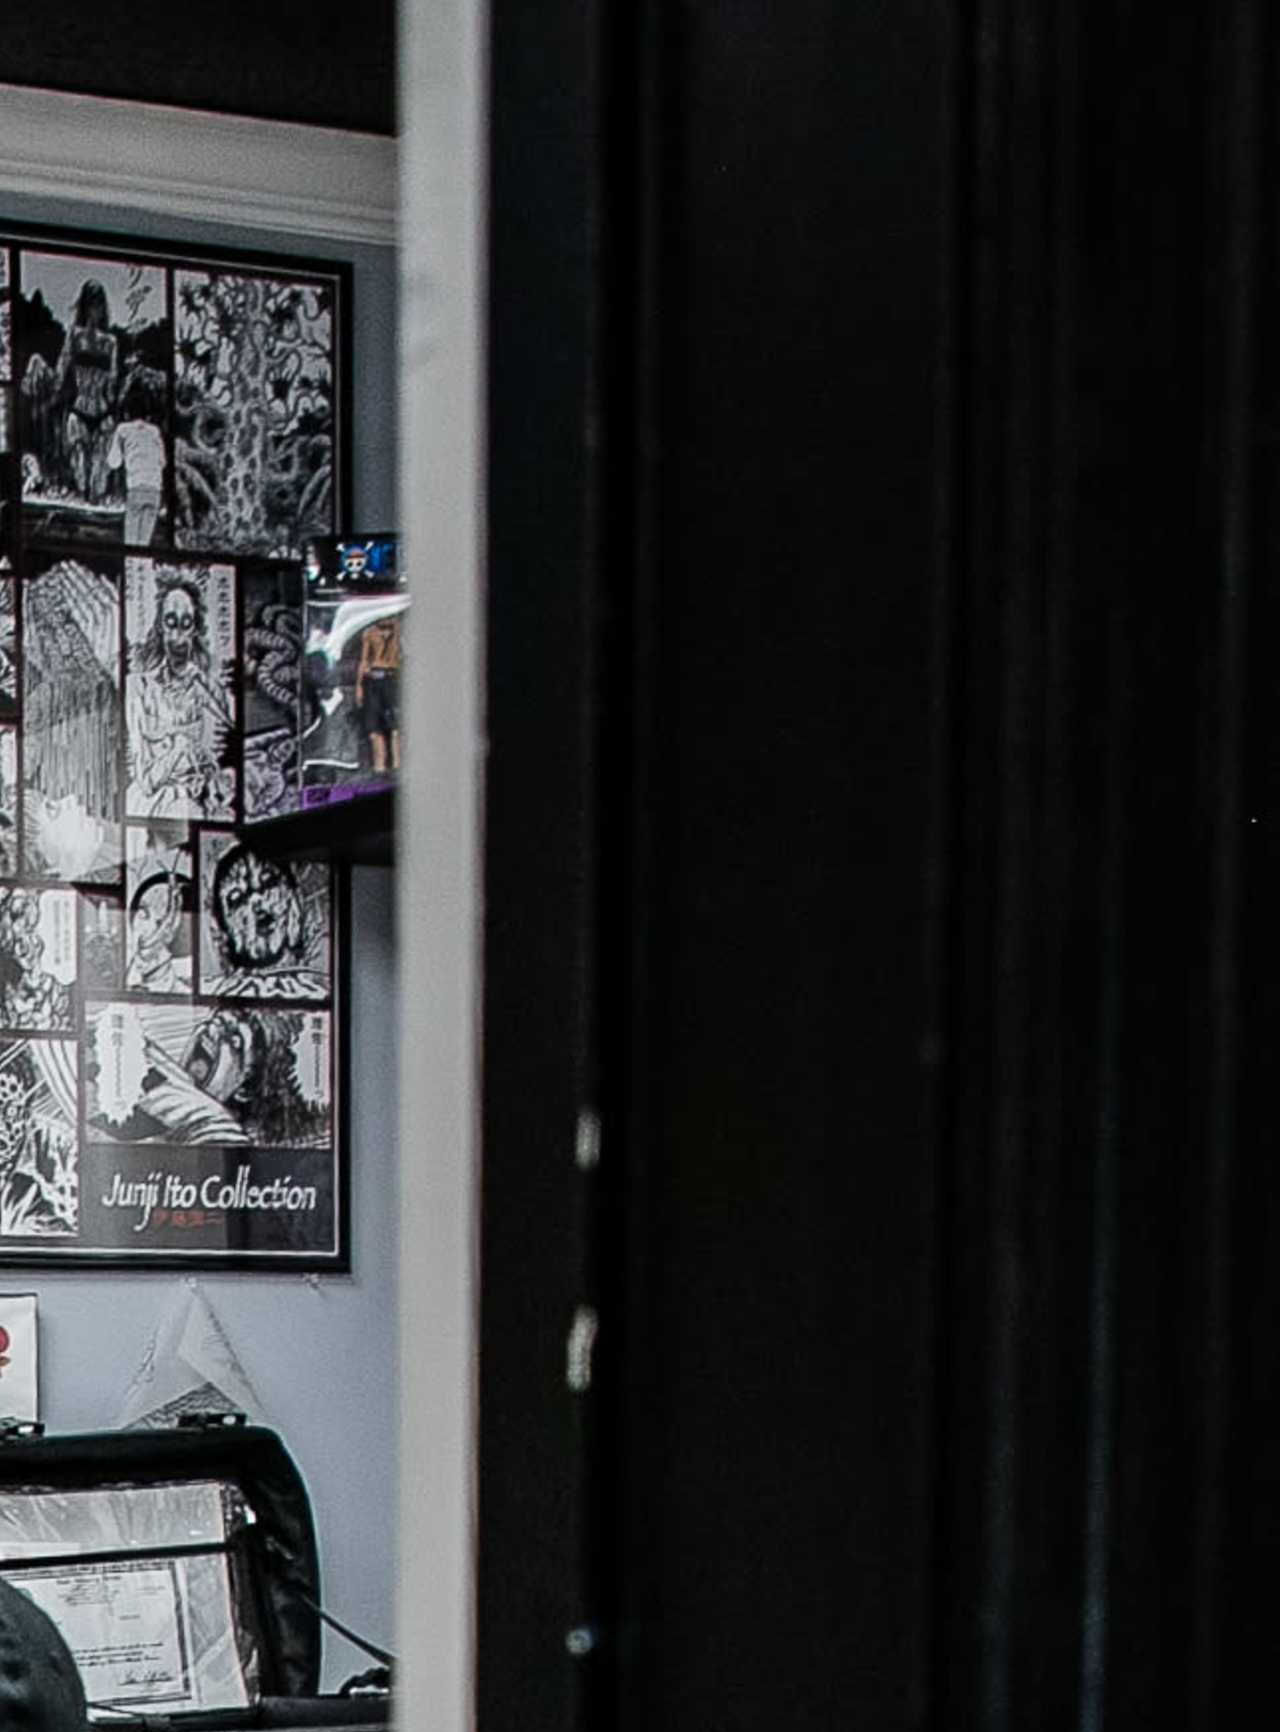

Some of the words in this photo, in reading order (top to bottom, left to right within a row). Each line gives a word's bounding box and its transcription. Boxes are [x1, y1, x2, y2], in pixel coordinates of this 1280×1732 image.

[102, 1171, 162, 1232] Junji
[162, 1174, 197, 1209] Ito
[200, 1165, 317, 1211] Collection
